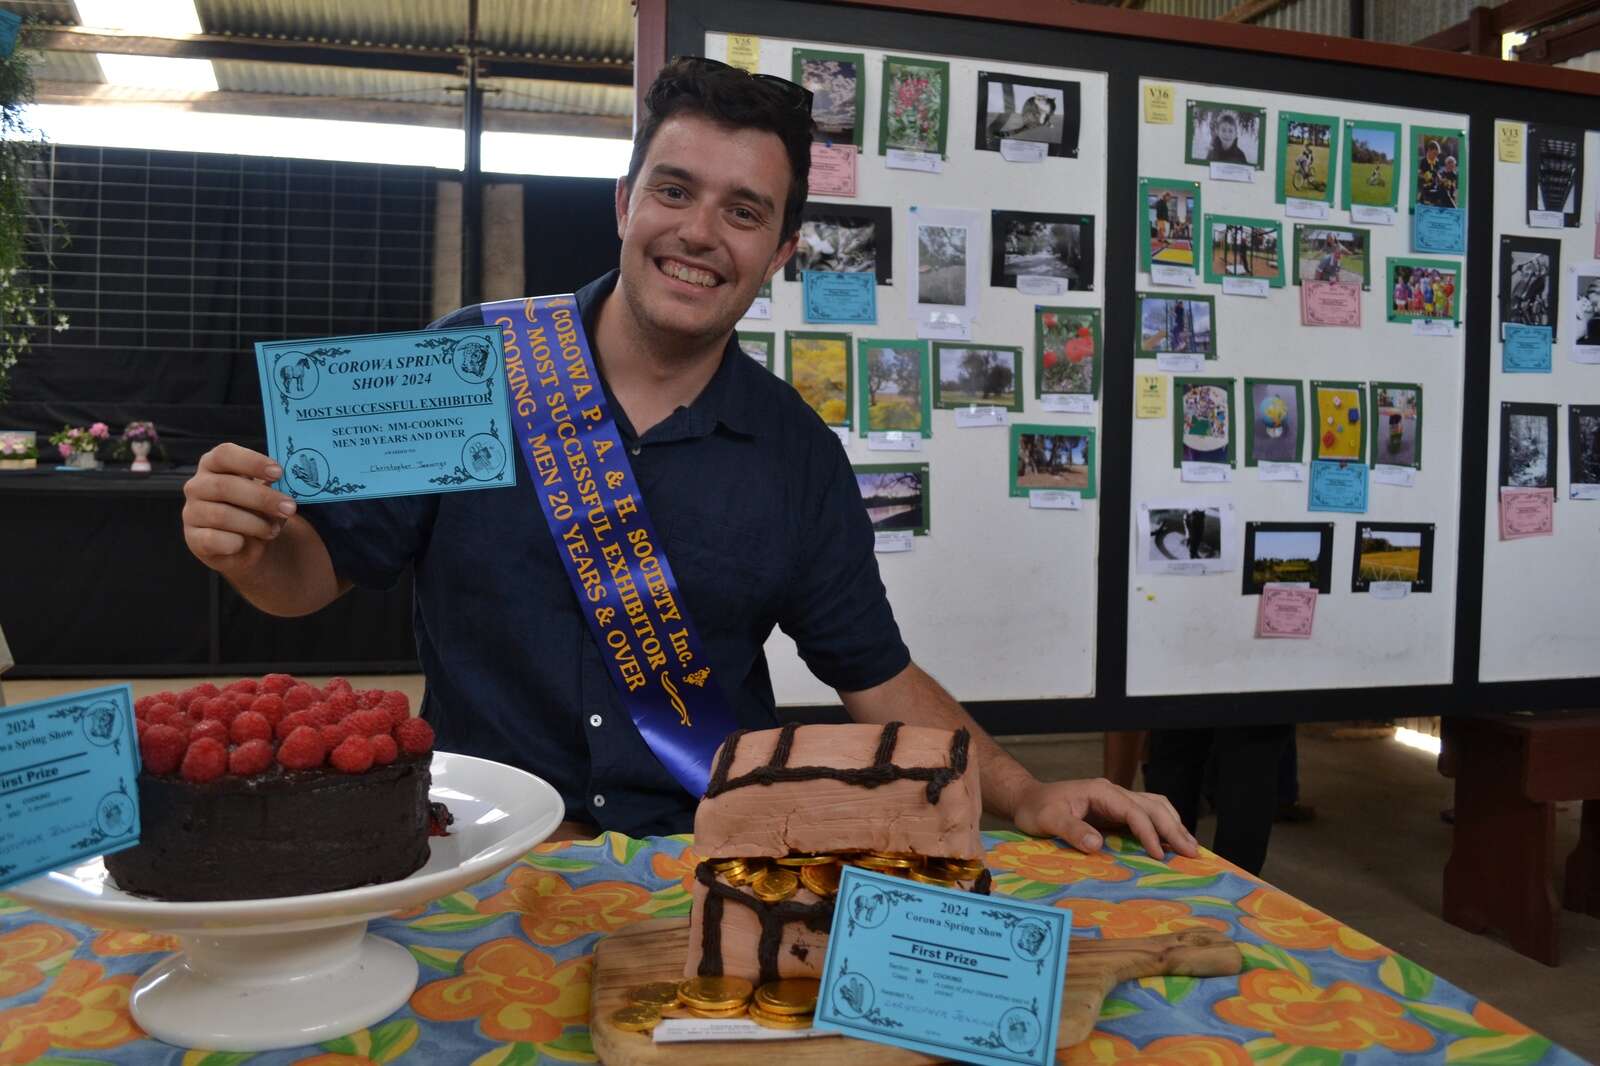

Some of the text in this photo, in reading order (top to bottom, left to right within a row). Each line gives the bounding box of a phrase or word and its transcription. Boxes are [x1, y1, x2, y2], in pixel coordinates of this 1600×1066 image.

[328, 354, 452, 375] COROWA SPRING
[352, 373, 432, 391] SHOW 2024
[296, 393, 493, 419] MOST SUCCESSFUL EXHIBITOR
[332, 417, 463, 437] SECTION: MM-COOKING
[332, 429, 466, 448] MEN 20 YEARS AND OVER
[527, 326, 667, 671] MOST SUCCESSFUL EXHIBITOR
[551, 310, 695, 668] COROWA P. A. & H. SOCIETY Inc.
[495, 316, 537, 417] COOKING
[528, 433, 563, 487] MEN
[548, 491, 574, 521] 20
[563, 523, 607, 603] YEARS
[595, 607, 615, 628] &
[606, 630, 647, 692] OVER
[6, 718, 36, 736] 2024
[15, 735, 48, 751] Spring
[48, 730, 74, 742] Show
[0, 766, 60, 789] irst Prize
[940, 902, 969, 918] 2024
[905, 911, 1003, 938] Corowa Spring Show
[911, 943, 979, 967] First Prize
